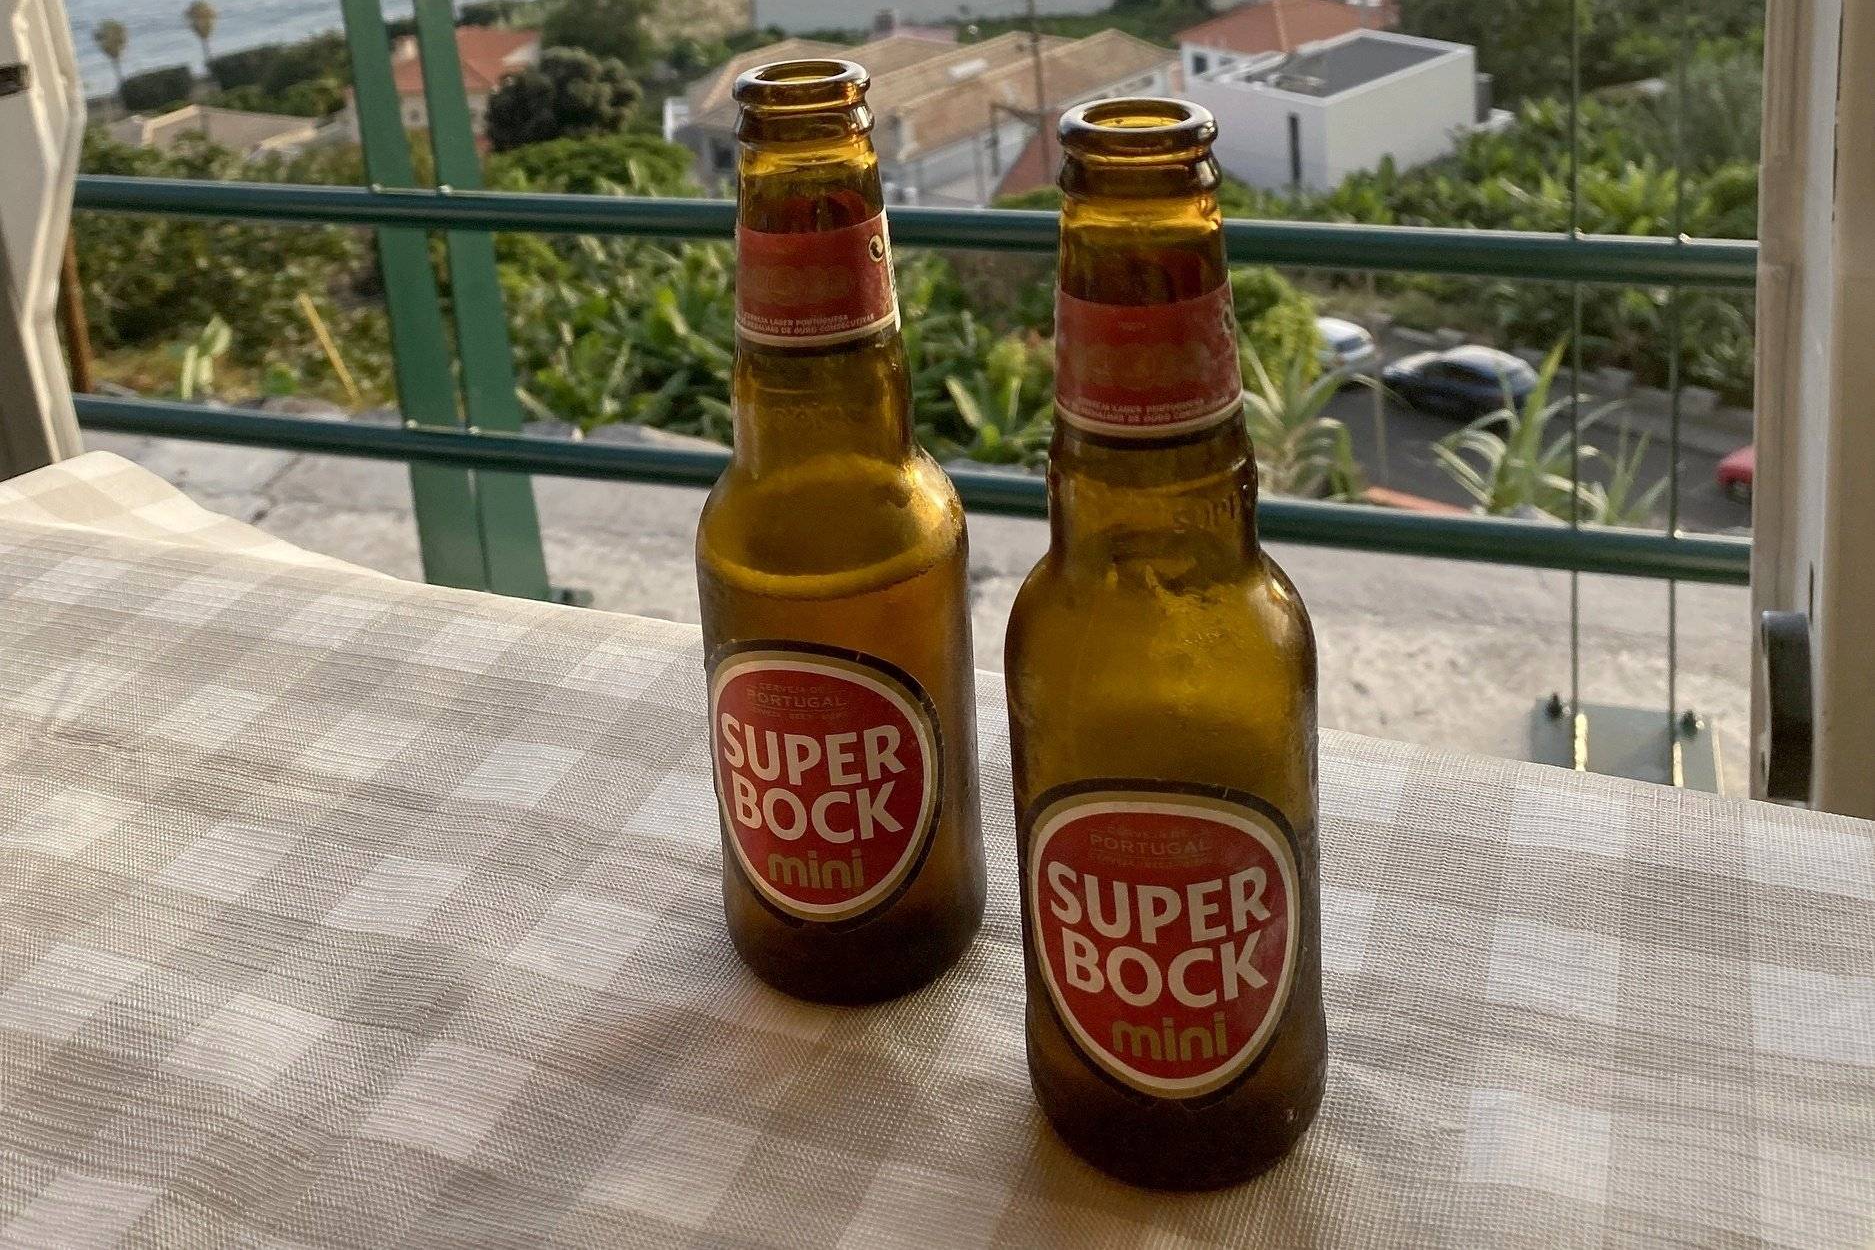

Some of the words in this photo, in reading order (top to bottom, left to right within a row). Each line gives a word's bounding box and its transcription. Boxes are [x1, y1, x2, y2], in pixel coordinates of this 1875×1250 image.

[746, 688, 848, 708] PORTUGAL
[720, 712, 906, 786] SUPER
[732, 770, 903, 844] BOCK
[767, 849, 864, 890] mini
[1090, 833, 1213, 855] PORTUGAL
[1047, 860, 1272, 944] SUPER
[1062, 927, 1268, 1008] BOCK
[1110, 1011, 1228, 1062] mini
